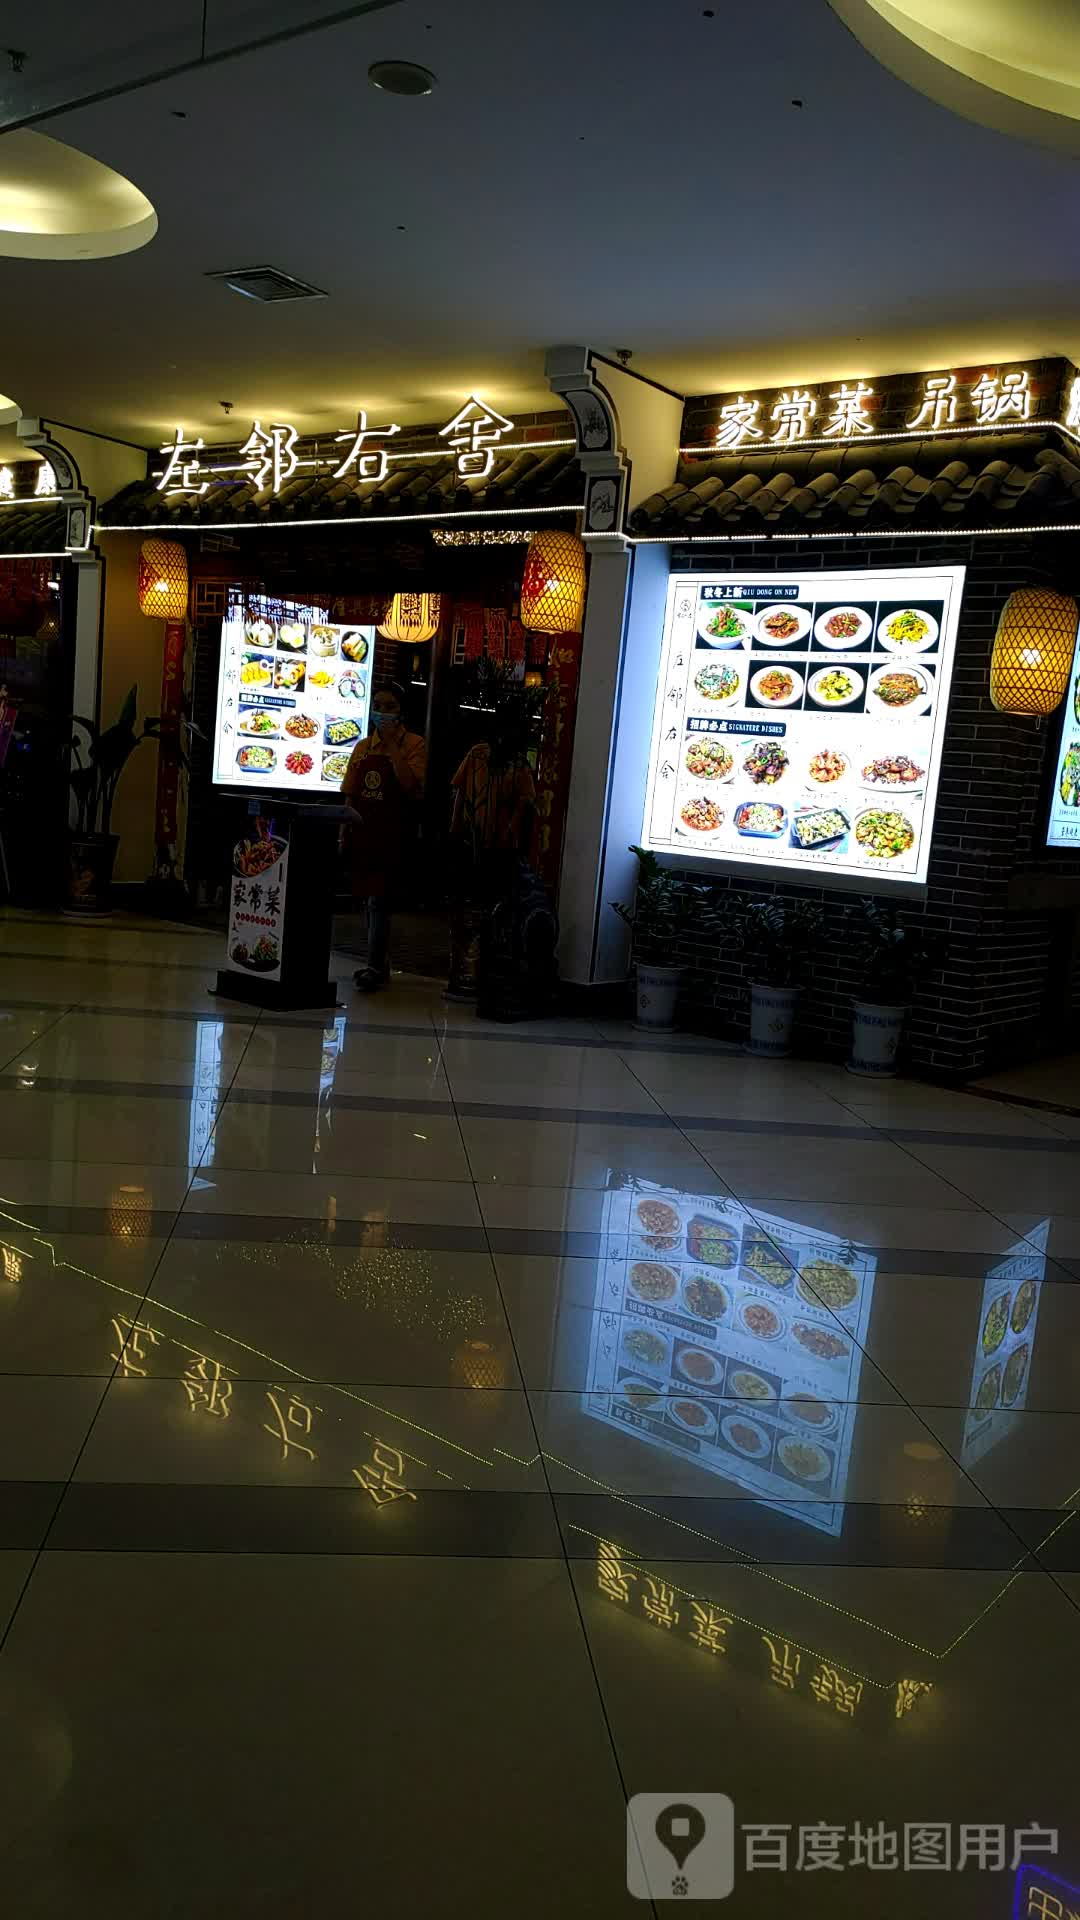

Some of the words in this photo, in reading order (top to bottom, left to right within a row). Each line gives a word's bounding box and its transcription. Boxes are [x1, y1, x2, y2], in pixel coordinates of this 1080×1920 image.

[716, 380, 873, 447] 家常菜
[906, 371, 1030, 429] 吊锅
[156, 394, 515, 495] 左邻右舍
[704, 587, 743, 598] 秋冬上新
[690, 719, 728, 731] 招牌必点
[233, 880, 281, 915] 家常菜
